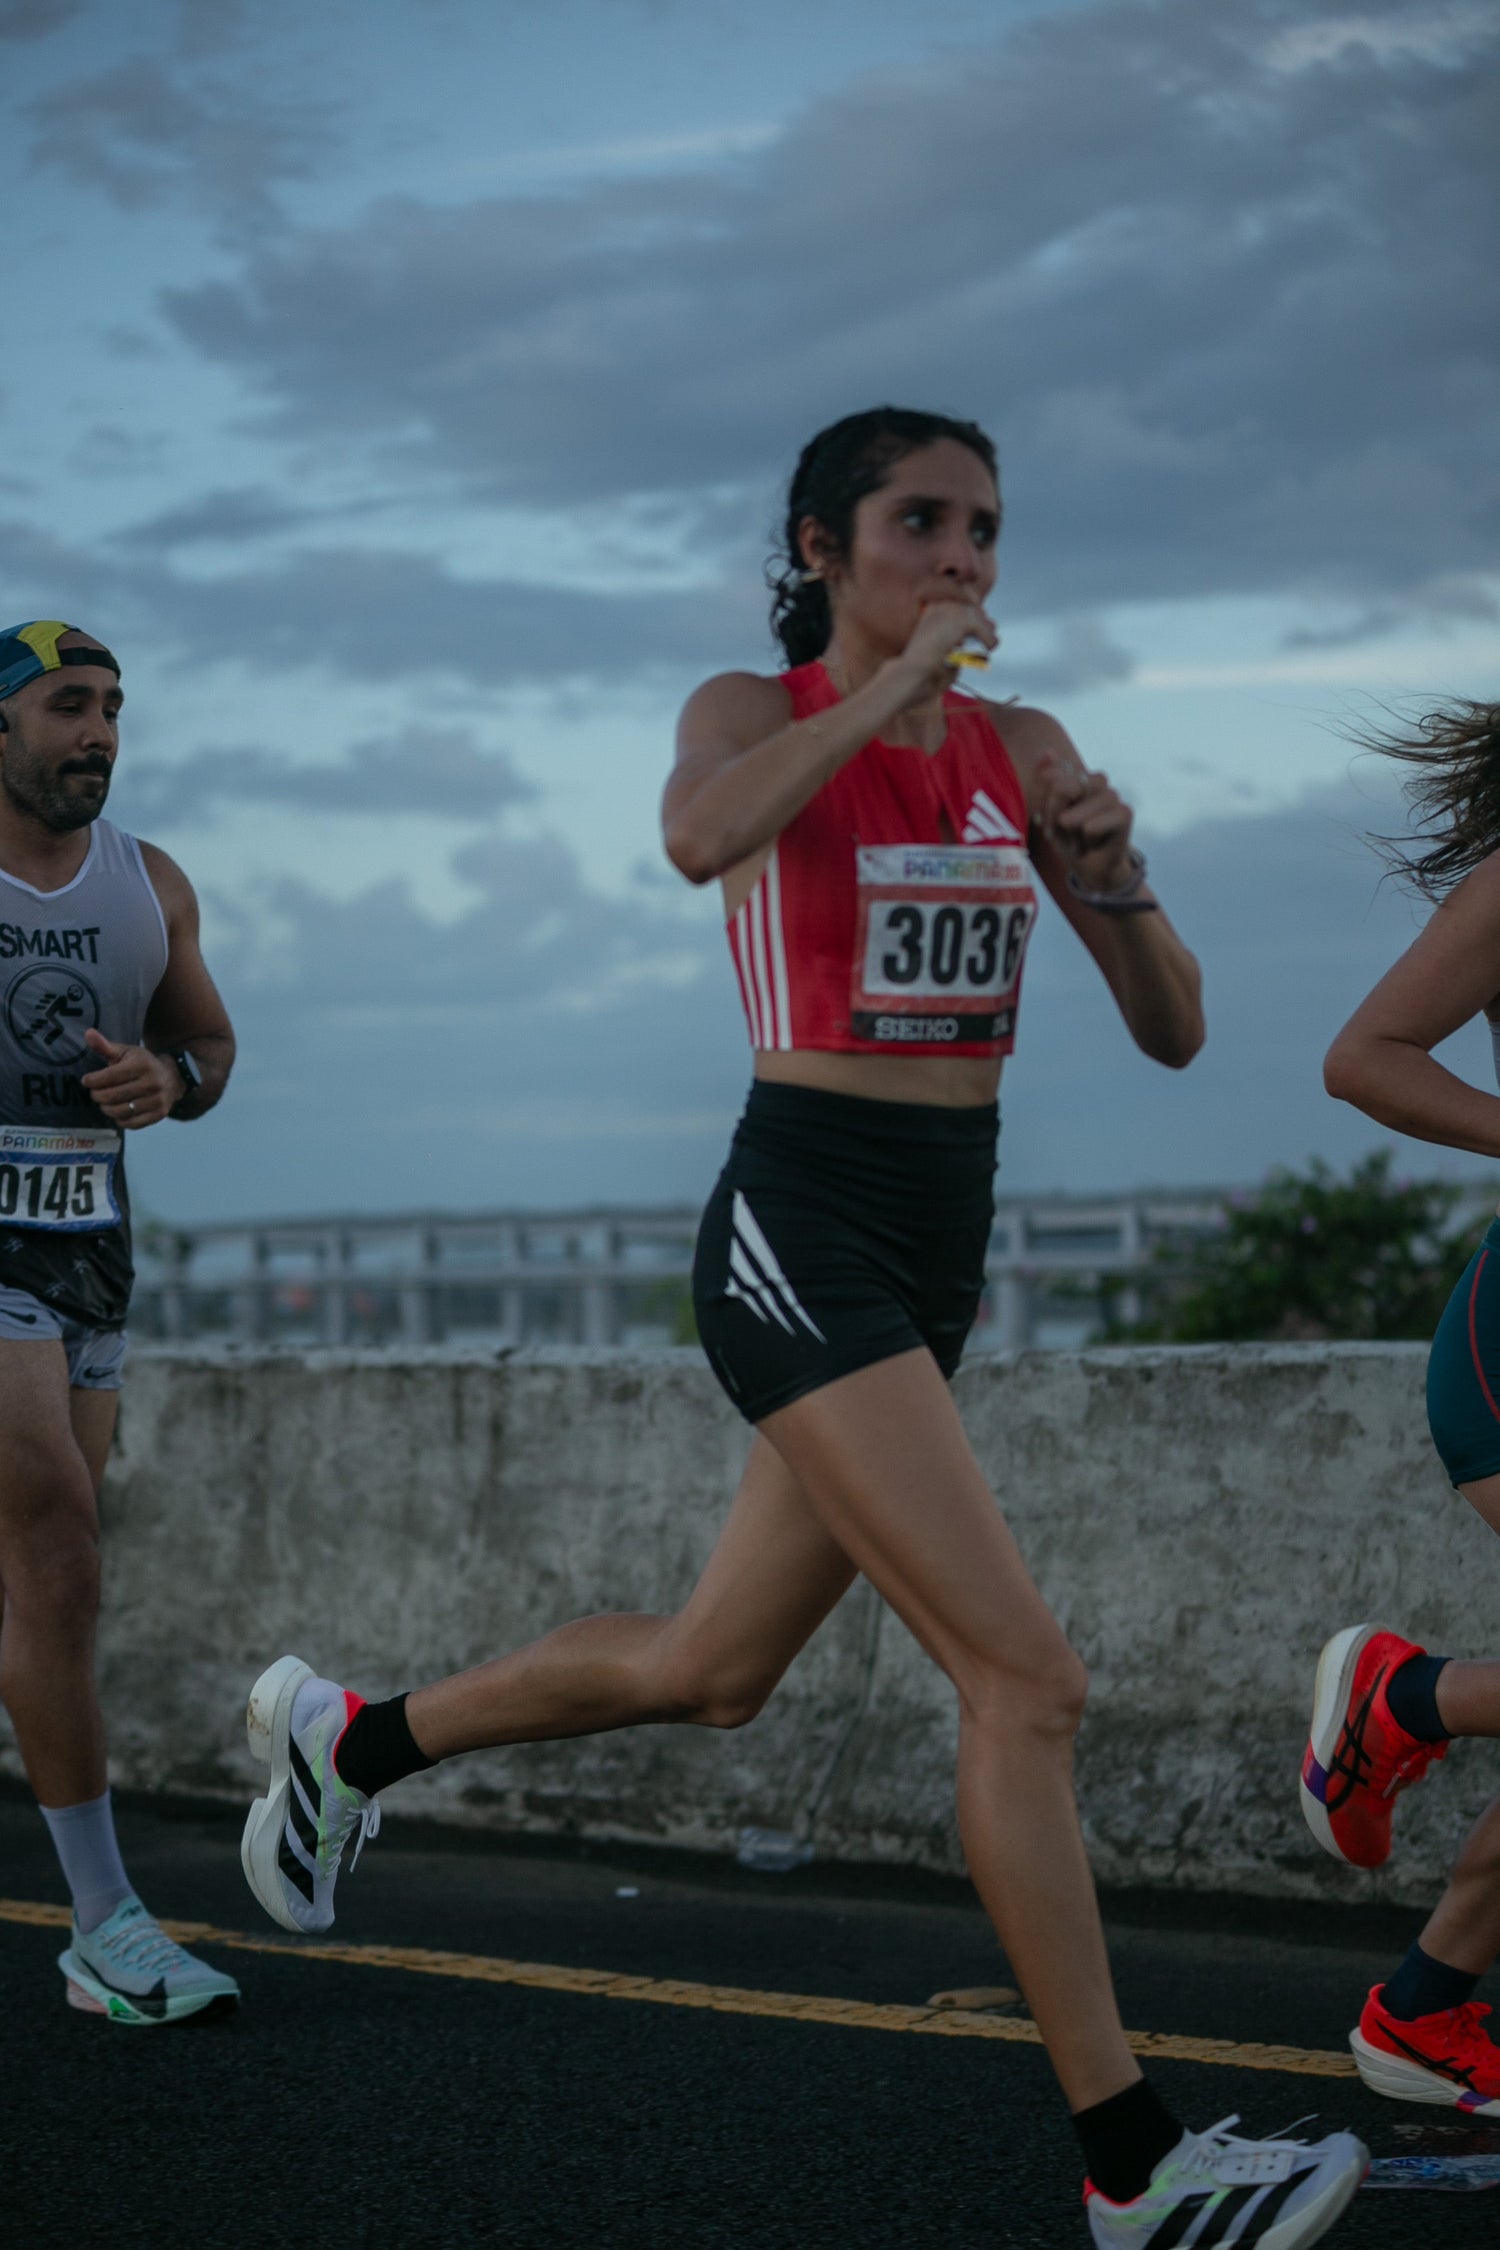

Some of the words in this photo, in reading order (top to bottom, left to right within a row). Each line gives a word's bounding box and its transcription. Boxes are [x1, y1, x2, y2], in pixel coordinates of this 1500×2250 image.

[0, 923, 100, 964] SMART
[882, 905, 1027, 985] 3036
[874, 1015, 959, 1041] SEIKO
[22, 1072, 91, 1107] RUN
[0, 1163, 95, 1220] 0145
